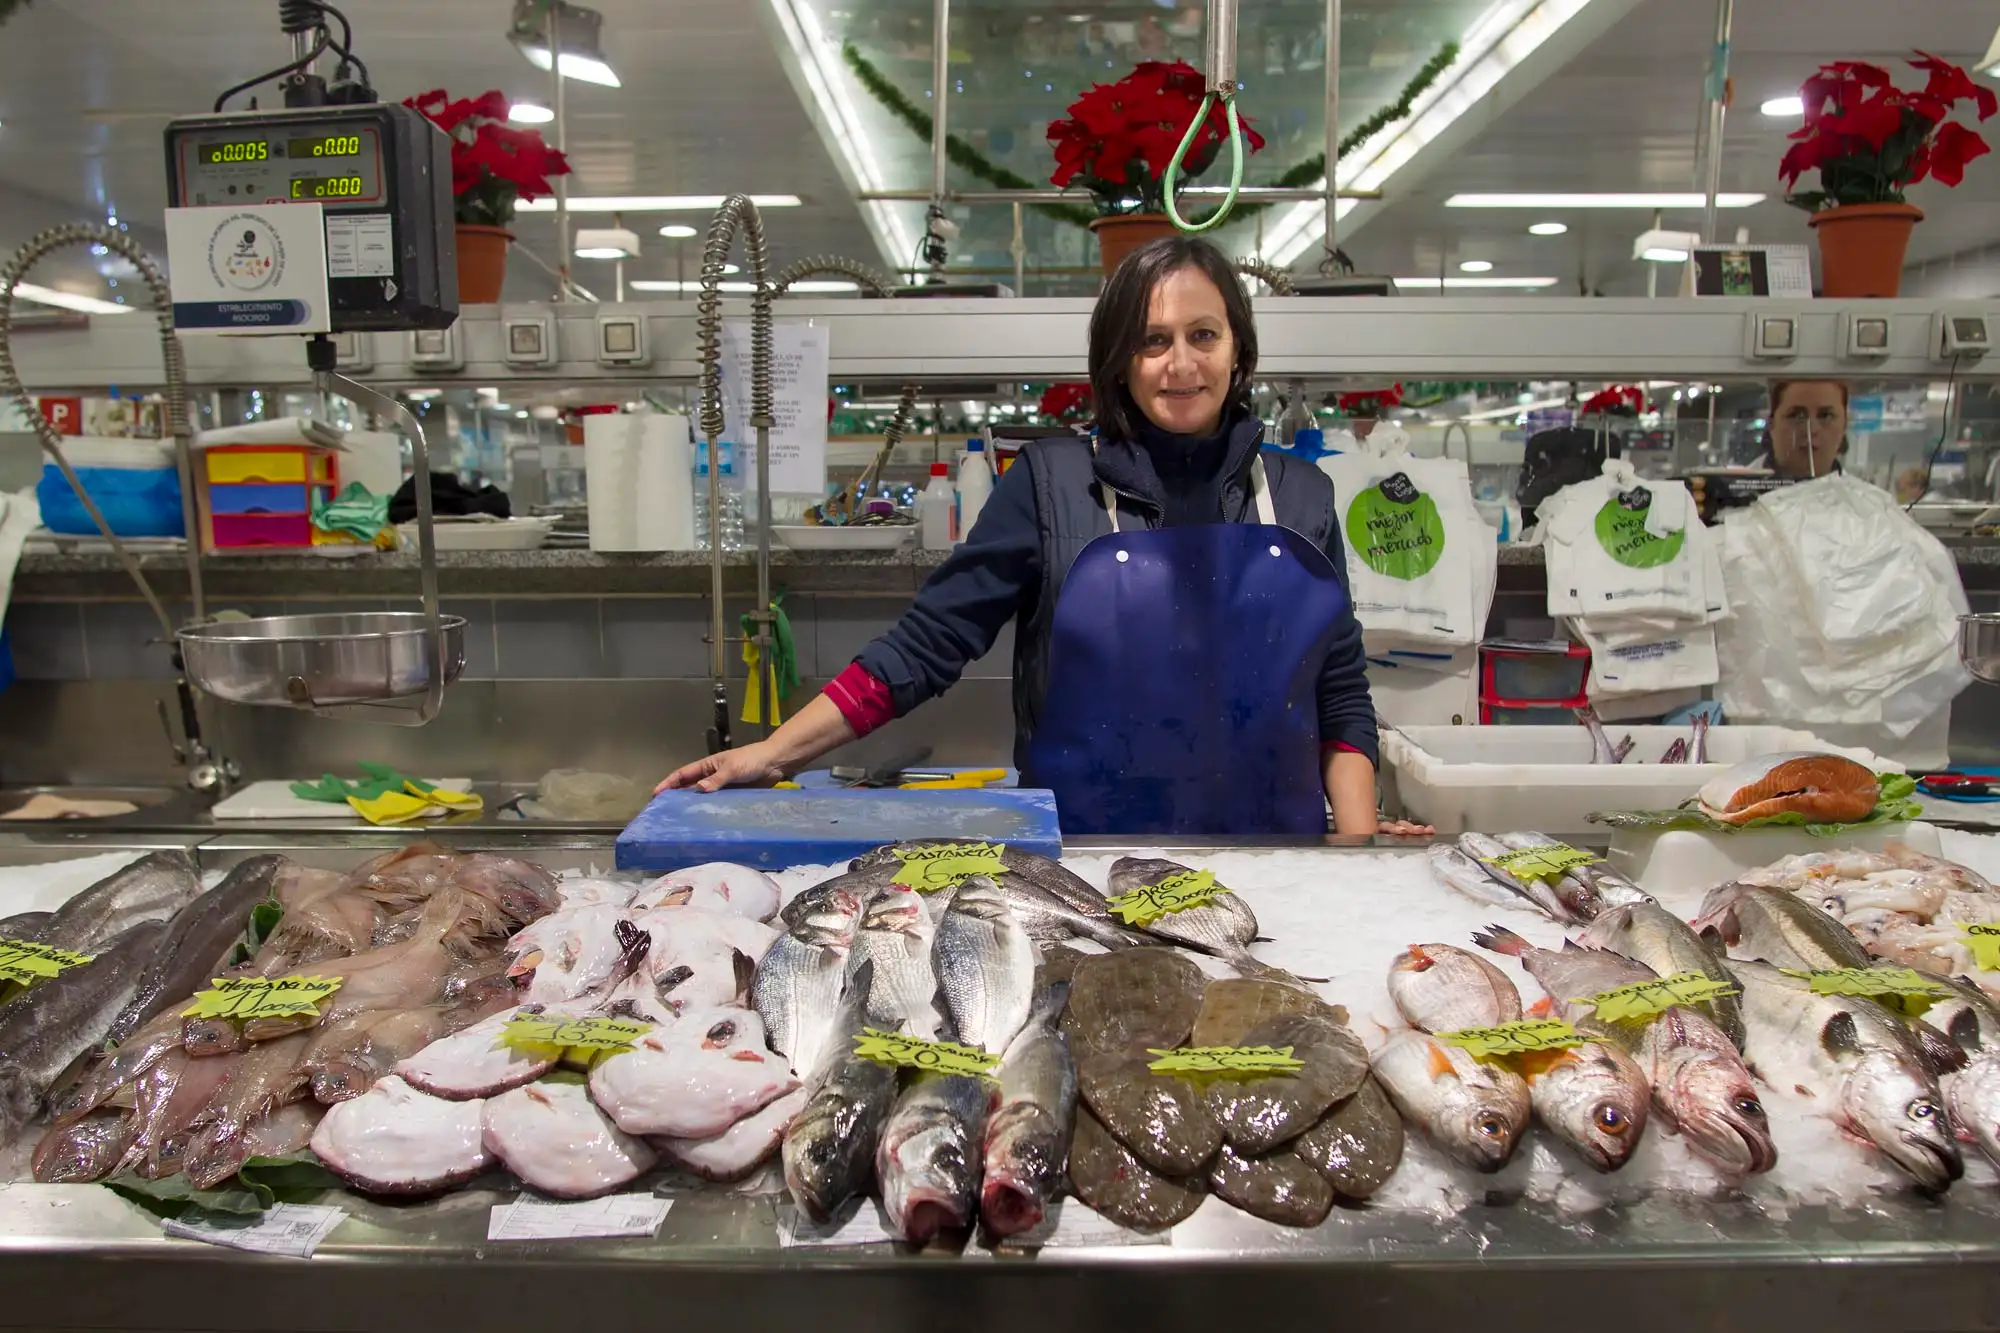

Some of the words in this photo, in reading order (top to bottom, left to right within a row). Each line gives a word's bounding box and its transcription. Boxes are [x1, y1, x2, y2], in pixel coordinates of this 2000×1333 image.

[218, 302, 283, 312] ESTABLECIMIENTO
[232, 313, 271, 323] ASOCIADO
[53, 404, 68, 423] P
[1366, 509, 1416, 533] mejor
[1368, 527, 1432, 559] mercado
[1120, 875, 1199, 905] SARGOS
[275, 980, 301, 991] DEL
[303, 983, 332, 992] DIA
[607, 1024, 641, 1035] DIA
